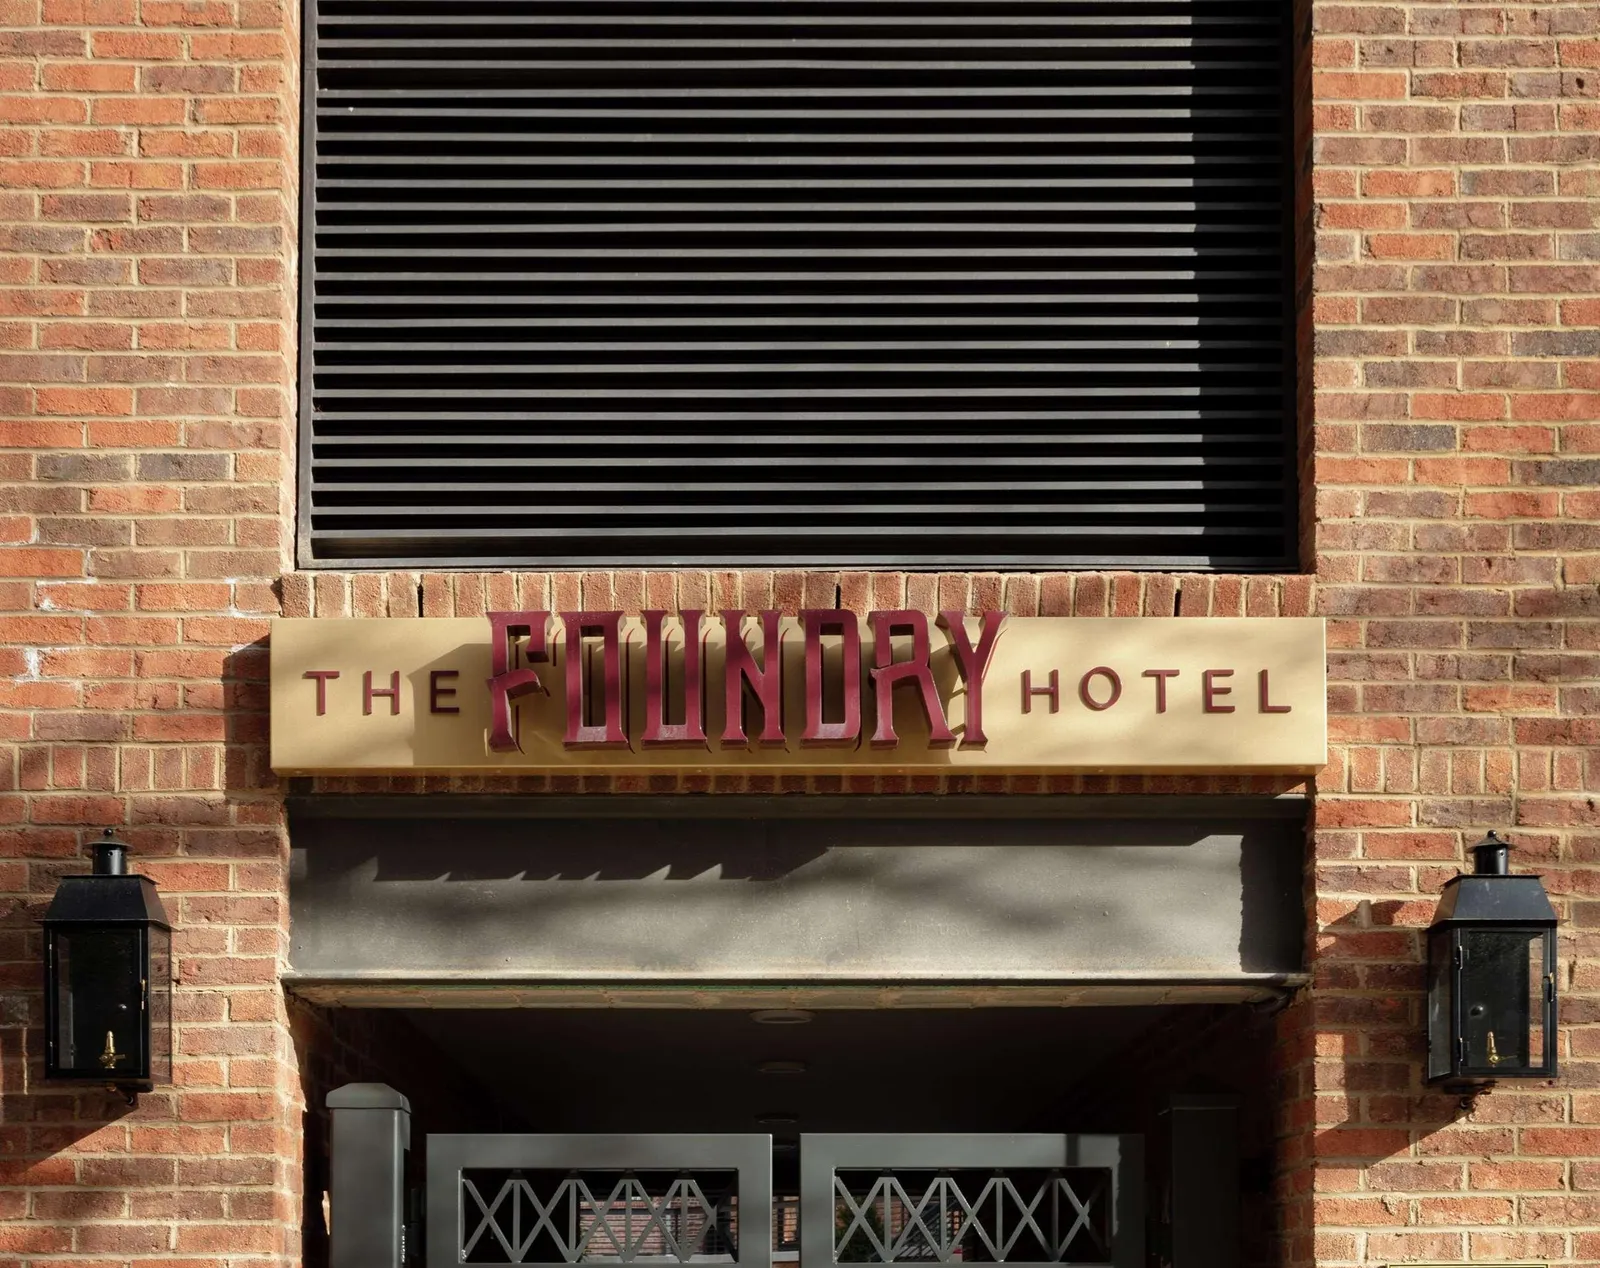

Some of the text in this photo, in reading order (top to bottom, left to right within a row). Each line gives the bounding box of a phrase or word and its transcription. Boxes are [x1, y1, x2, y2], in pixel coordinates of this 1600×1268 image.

[305, 609, 1292, 752] THE FOUNDRY HOTEL
